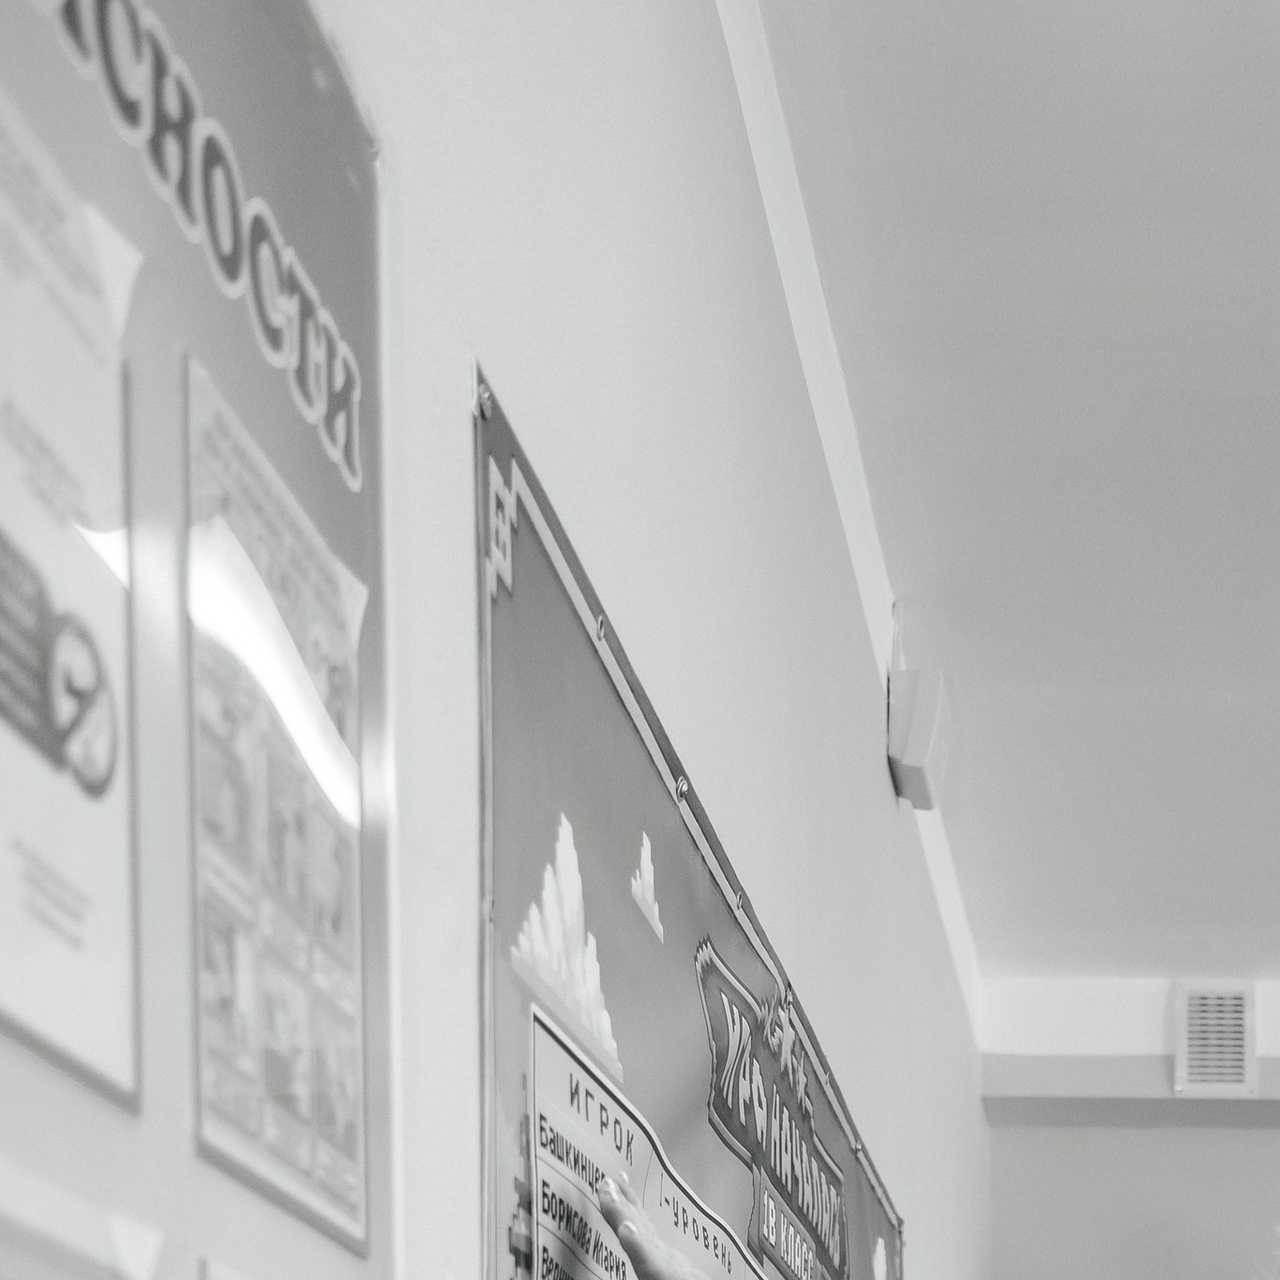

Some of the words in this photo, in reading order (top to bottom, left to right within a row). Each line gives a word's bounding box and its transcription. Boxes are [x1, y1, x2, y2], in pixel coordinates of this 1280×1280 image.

[539, 1112, 605, 1195] Башкинце
[569, 1073, 634, 1167] ИГРОК
[542, 1179, 592, 1255] Борисова
